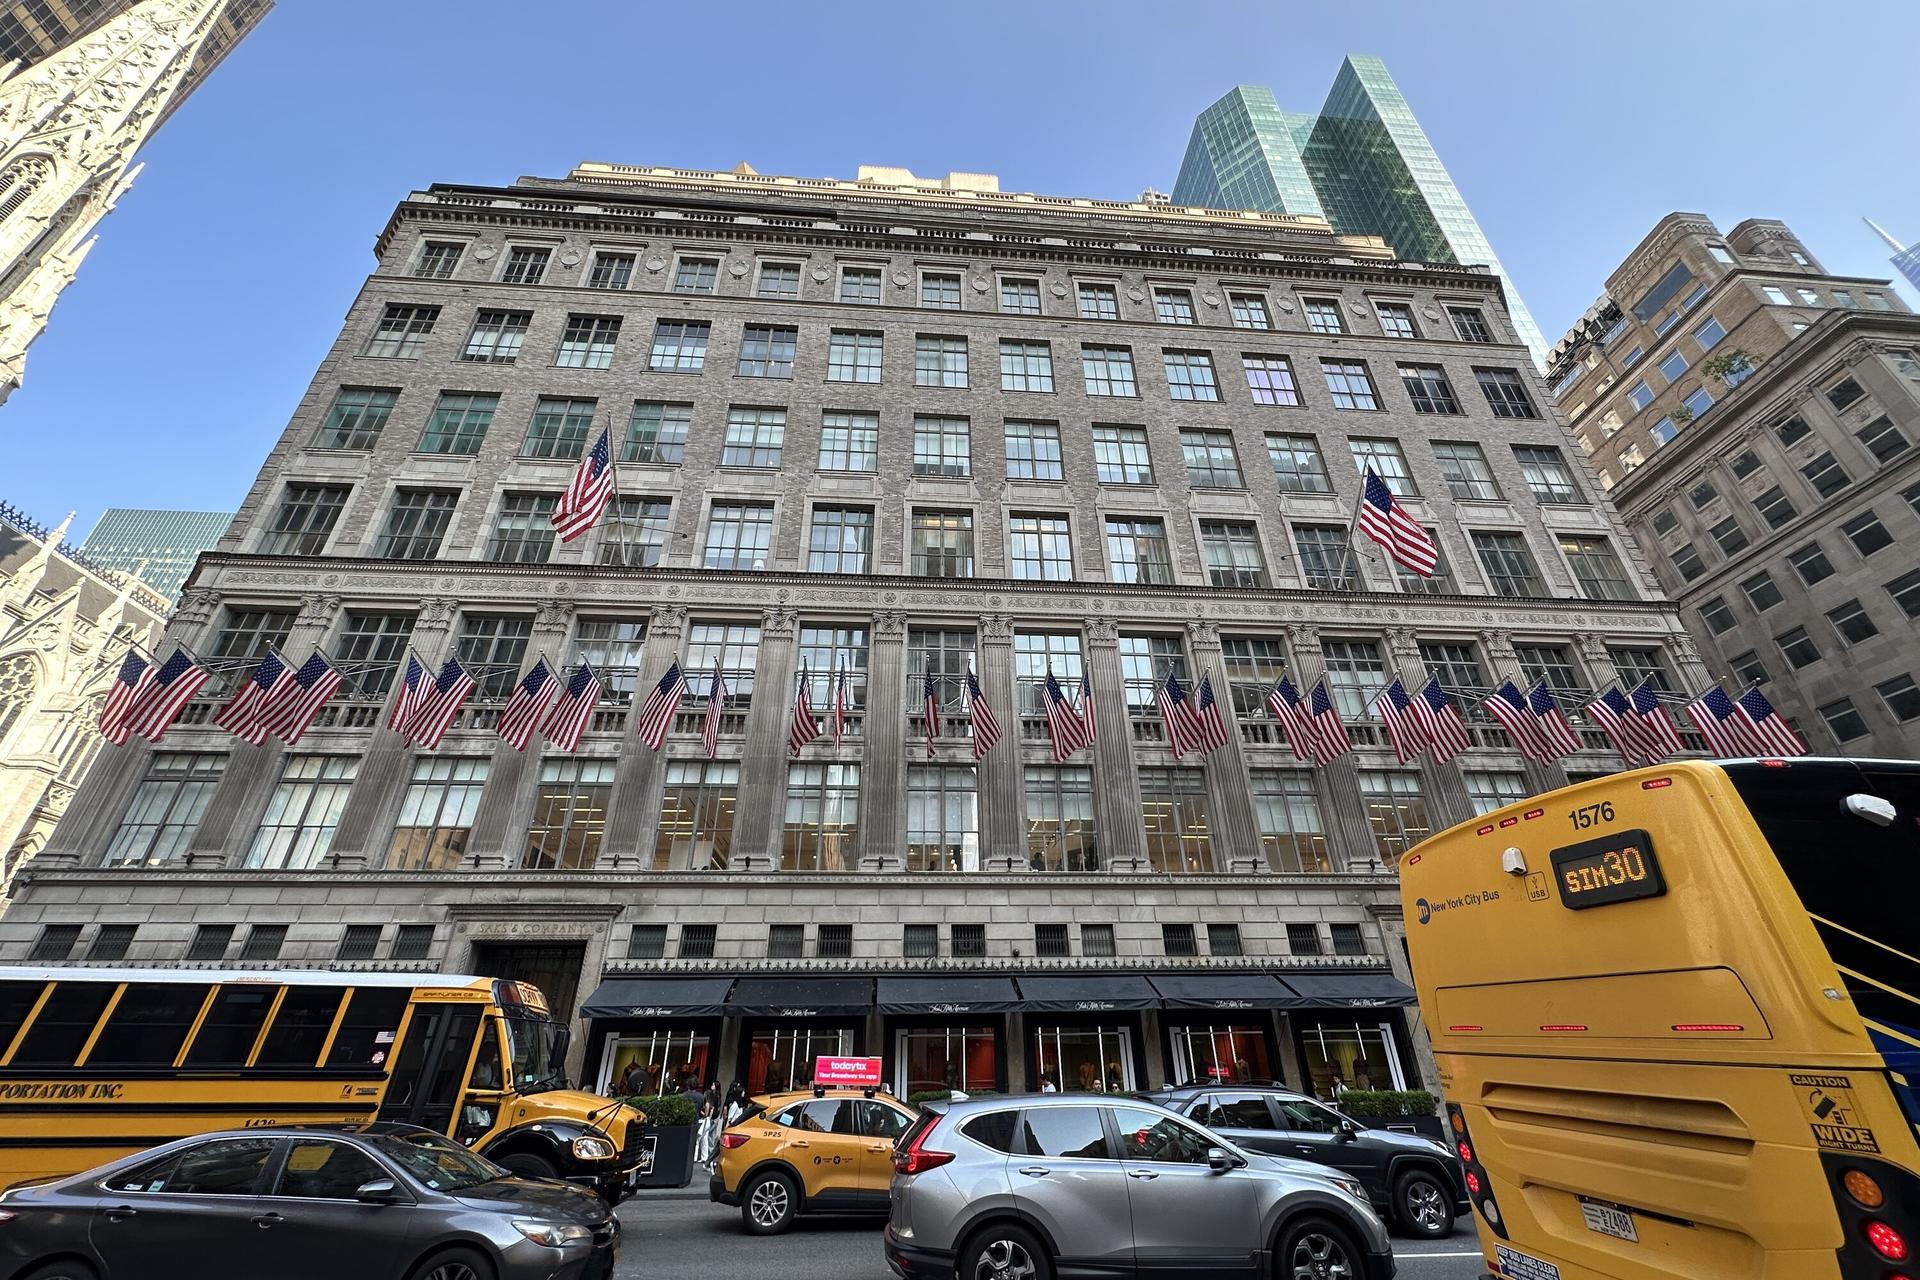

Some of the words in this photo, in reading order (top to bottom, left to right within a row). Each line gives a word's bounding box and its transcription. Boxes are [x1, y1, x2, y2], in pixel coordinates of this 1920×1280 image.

[1569, 801, 1615, 830] 1576
[1566, 847, 1646, 893] SIM30
[1431, 902, 1446, 913] New
[1446, 898, 1464, 909] York
[1464, 894, 1481, 906] City
[1482, 890, 1500, 902] Bus
[1531, 890, 1546, 899] USB
[480, 923, 507, 933] SAKS
[511, 923, 518, 933] &
[523, 923, 586, 935] COMPANY
[831, 1061, 867, 1071] todaytix
[1792, 1075, 1849, 1087] CAUTION
[0, 1083, 90, 1099] PORTATION
[90, 1083, 123, 1099] INC.
[1812, 1124, 1875, 1145] WIDE
[1819, 1139, 1845, 1148] RIGHT
[1845, 1141, 1878, 1152] TURNS
